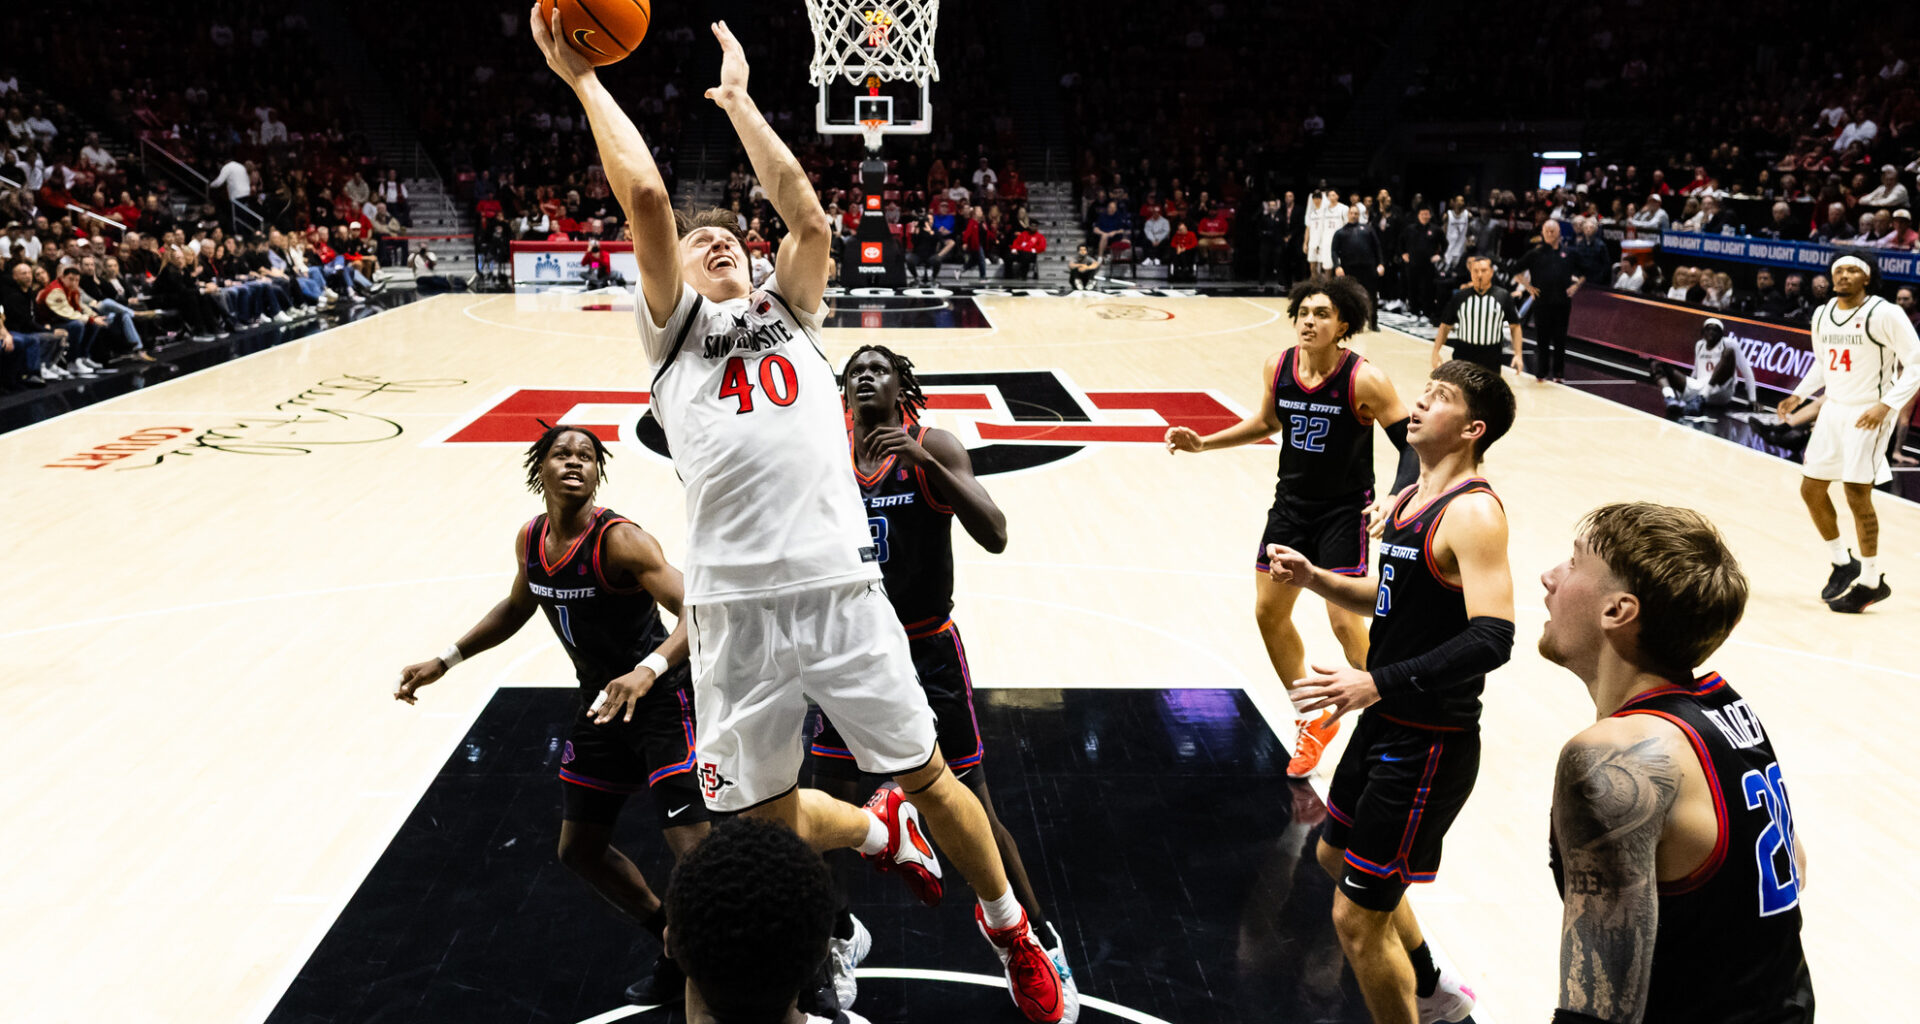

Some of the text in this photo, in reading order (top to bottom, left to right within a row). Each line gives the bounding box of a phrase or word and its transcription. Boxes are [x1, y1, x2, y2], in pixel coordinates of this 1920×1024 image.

[1703, 239, 1745, 256] BUD LIGHT
[1749, 244, 1795, 262] BUD LIGHT
[1799, 249, 1819, 264] BUD
[1878, 257, 1912, 275] LIGHT
[1829, 348, 1852, 372] 24
[718, 353, 799, 415] 40
[1279, 399, 1342, 415] BOISE STATE
[1290, 414, 1330, 453] 22
[42, 426, 194, 471] COURT
[871, 492, 916, 508] STATE
[1391, 545, 1420, 560] STATE
[555, 586, 596, 600] STATE
[1375, 563, 1395, 617] 6
[555, 605, 576, 648] 1
